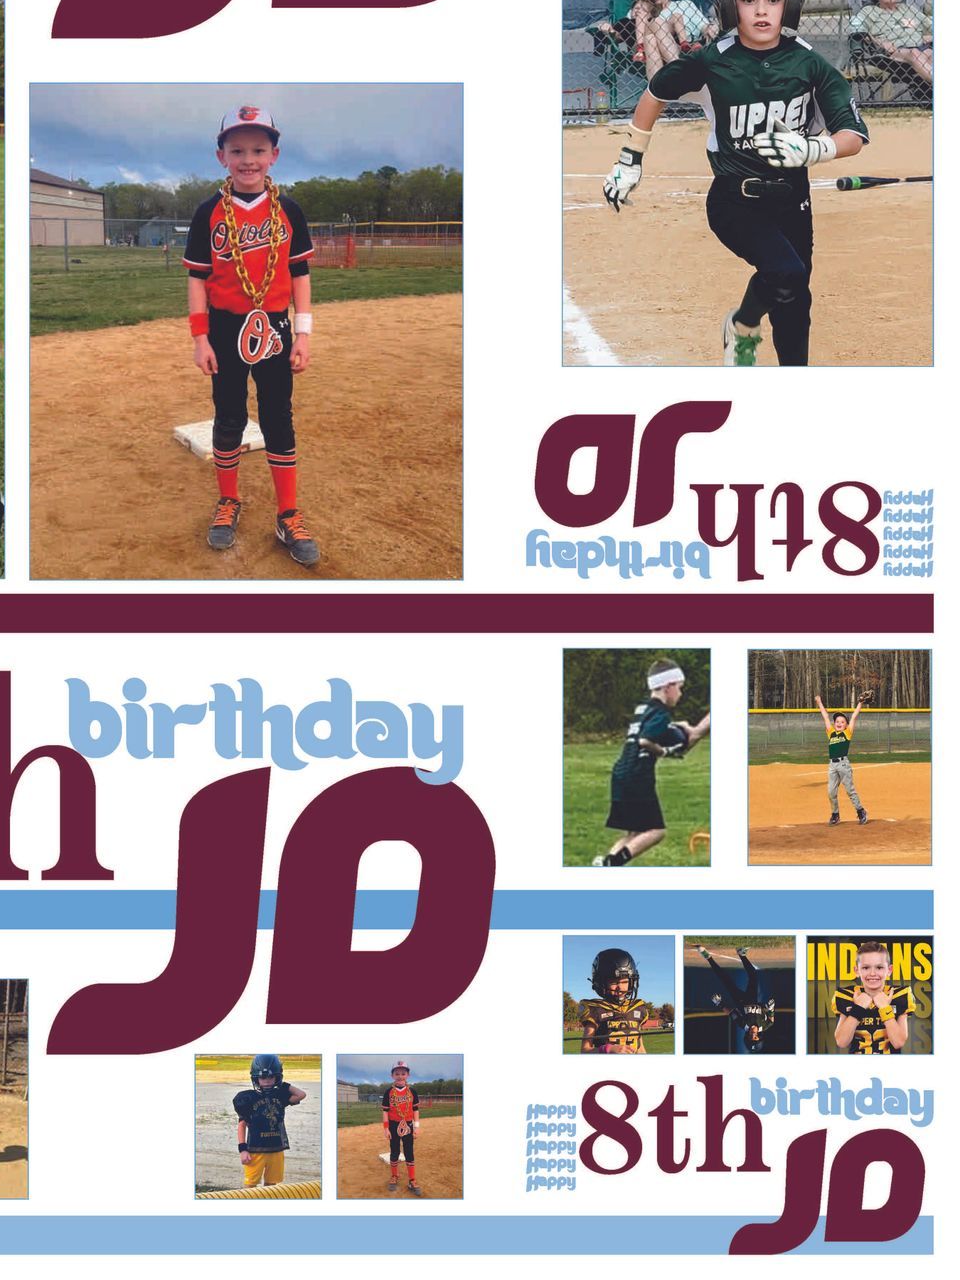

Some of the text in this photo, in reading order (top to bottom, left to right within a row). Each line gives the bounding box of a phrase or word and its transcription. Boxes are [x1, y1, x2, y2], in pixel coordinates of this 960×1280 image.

[884, 490, 933, 506] Happy
[884, 508, 933, 524] Happy
[690, 482, 881, 581] 8th
[884, 526, 933, 541] Happy
[526, 529, 711, 581] birthday
[884, 544, 933, 559] Happy
[884, 561, 933, 577] Happy
[66, 678, 463, 784] birthday
[807, 942, 933, 982] INDNS
[750, 1078, 933, 1127] birthday
[527, 1104, 576, 1120] Happy
[527, 1122, 576, 1138] Happy
[580, 1075, 770, 1174] 8th
[527, 1140, 576, 1156] Happy
[527, 1158, 576, 1174] Happy
[527, 1176, 576, 1192] Happy
